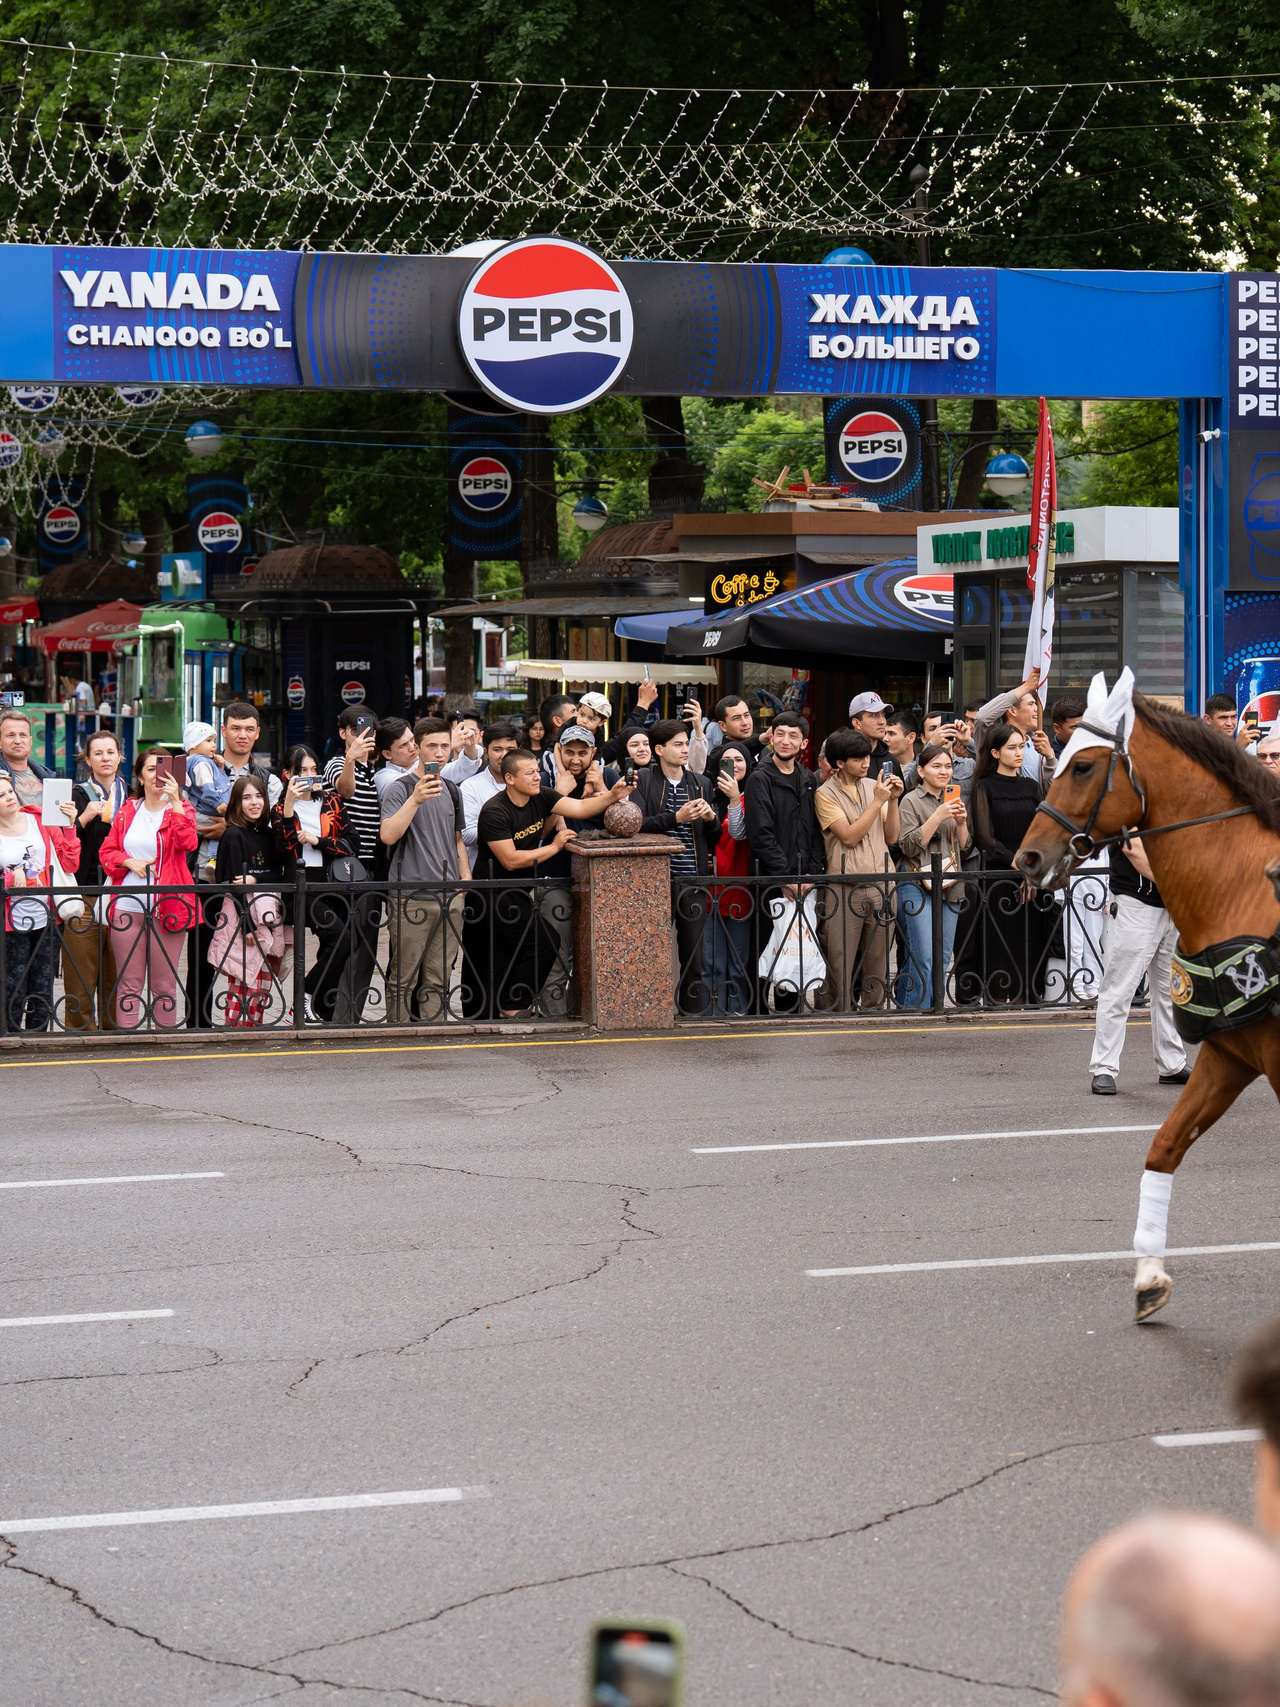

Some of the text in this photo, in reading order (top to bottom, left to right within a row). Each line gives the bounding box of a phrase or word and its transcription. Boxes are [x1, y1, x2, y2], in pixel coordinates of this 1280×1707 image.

[59, 270, 281, 311] YANADA
[808, 293, 980, 331] ЖАЖДА
[67, 323, 221, 347] CHANQOQ
[473, 307, 622, 343] PEPSI
[809, 334, 980, 361] БОЛЬШЕГО
[844, 439, 903, 455] PEPSI
[462, 478, 508, 490] PEPSI
[46, 520, 78, 529] PEPSI
[201, 529, 239, 538] PEPSI
[711, 573, 760, 604] Coffee
[702, 630, 722, 648] PEPSI
[336, 661, 371, 671] PEPSI
